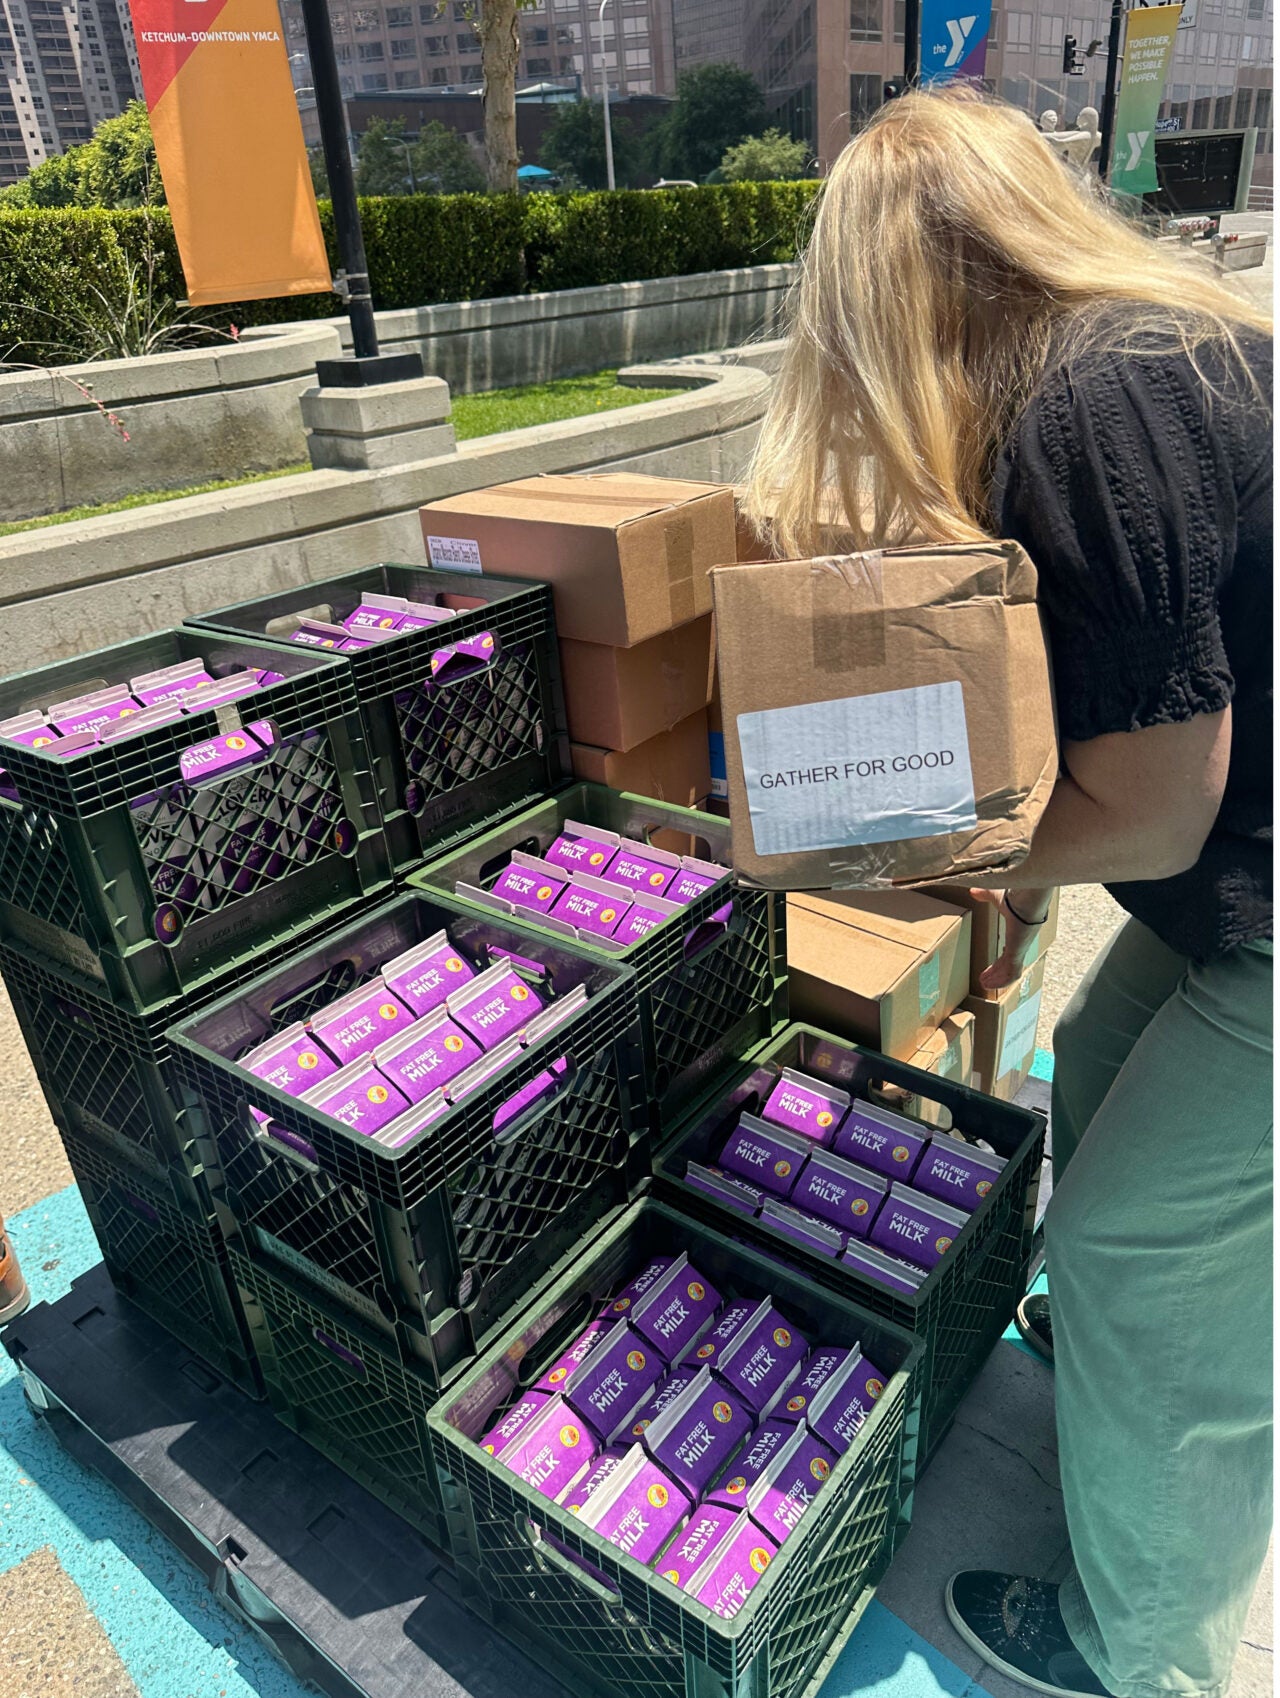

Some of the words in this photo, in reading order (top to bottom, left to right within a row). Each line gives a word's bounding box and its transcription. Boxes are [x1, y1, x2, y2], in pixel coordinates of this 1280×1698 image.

[141, 31, 251, 42] KETCHUM-DOWNTOWN
[252, 31, 280, 41] YMCA
[1129, 35, 1171, 48] TOGETHER,
[933, 43, 947, 54] the
[1131, 50, 1143, 60] WE
[1143, 48, 1166, 57] MAKE
[1129, 60, 1163, 71] POSSIBLE
[1128, 71, 1158, 83] HAPPEN.
[353, 617, 373, 626] MILK
[183, 749, 222, 769] MILK
[194, 743, 216, 757] FREE
[760, 765, 838, 789] GATHER
[844, 759, 886, 779] FOR
[892, 750, 955, 772] GOOD
[558, 846, 583, 860] MILK
[573, 844, 590, 853] FREE
[615, 866, 644, 880] MILK
[630, 864, 648, 873] FREE
[504, 879, 531, 894] MILK
[520, 877, 536, 887] FREE
[566, 900, 594, 916] MILK
[582, 898, 599, 909] FREE
[406, 981, 420, 992] FAT
[419, 968, 439, 984] FREE
[413, 973, 445, 998] MILK
[472, 1011, 486, 1022] FAT
[485, 997, 504, 1014] FREE
[478, 1002, 510, 1028] MILK
[334, 1028, 351, 1040] FAT
[350, 1015, 371, 1032] FREE
[341, 1022, 377, 1048] MILK
[401, 1064, 416, 1076] FAT
[415, 1048, 437, 1068] FREE
[408, 1055, 443, 1082] MILK
[334, 1100, 358, 1118] FREE
[779, 1098, 810, 1118] MILK
[782, 1092, 796, 1102] FAT
[794, 1096, 813, 1109] FREE
[851, 1132, 884, 1152] MILK
[854, 1125, 870, 1136] FAT
[868, 1131, 887, 1144] FREE
[735, 1146, 766, 1167] MILK
[739, 1139, 754, 1149] FAT
[752, 1144, 772, 1158] FREE
[931, 1167, 964, 1187] MILK
[934, 1158, 951, 1170] FAT
[950, 1166, 970, 1178] FREE
[808, 1184, 842, 1206] MILK
[812, 1175, 829, 1187] FAT
[827, 1182, 846, 1196] FREE
[889, 1221, 923, 1244] MILK
[893, 1212, 910, 1224] FAT
[908, 1219, 930, 1234] FREE
[631, 1265, 658, 1292] MILK
[654, 1313, 668, 1330] FAT
[663, 1296, 683, 1316] FREE
[660, 1307, 690, 1339] MILK
[737, 1308, 748, 1321] FAT
[713, 1308, 741, 1340] MILK
[722, 1320, 737, 1338] FREE
[740, 1362, 754, 1379] FAT
[752, 1345, 769, 1364] FREE
[748, 1353, 777, 1387] MILK
[801, 1356, 830, 1386] MILK
[825, 1356, 837, 1370] FAT
[588, 1387, 604, 1403] FAT
[602, 1368, 621, 1389] FREE
[811, 1370, 827, 1390] FREE
[596, 1377, 628, 1413] MILK
[650, 1379, 681, 1410] MILK
[496, 1403, 527, 1436] MILK
[526, 1403, 537, 1418] FAT
[833, 1417, 848, 1434] FAT
[845, 1397, 861, 1418] FREE
[504, 1417, 523, 1438] FREE
[675, 1443, 690, 1460] FAT
[688, 1421, 707, 1445] FREE
[683, 1429, 716, 1468] MILK
[743, 1432, 769, 1466] MILK
[769, 1433, 781, 1445] FAT
[531, 1446, 551, 1468] FREE
[753, 1445, 768, 1470] FREE
[774, 1501, 788, 1522] FAT
[785, 1479, 804, 1504] FREE
[620, 1506, 640, 1533] FREE
[708, 1521, 720, 1538] FAT
[677, 1519, 711, 1558] MILK
[687, 1538, 709, 1563] FREE
[723, 1572, 744, 1599] FREE
